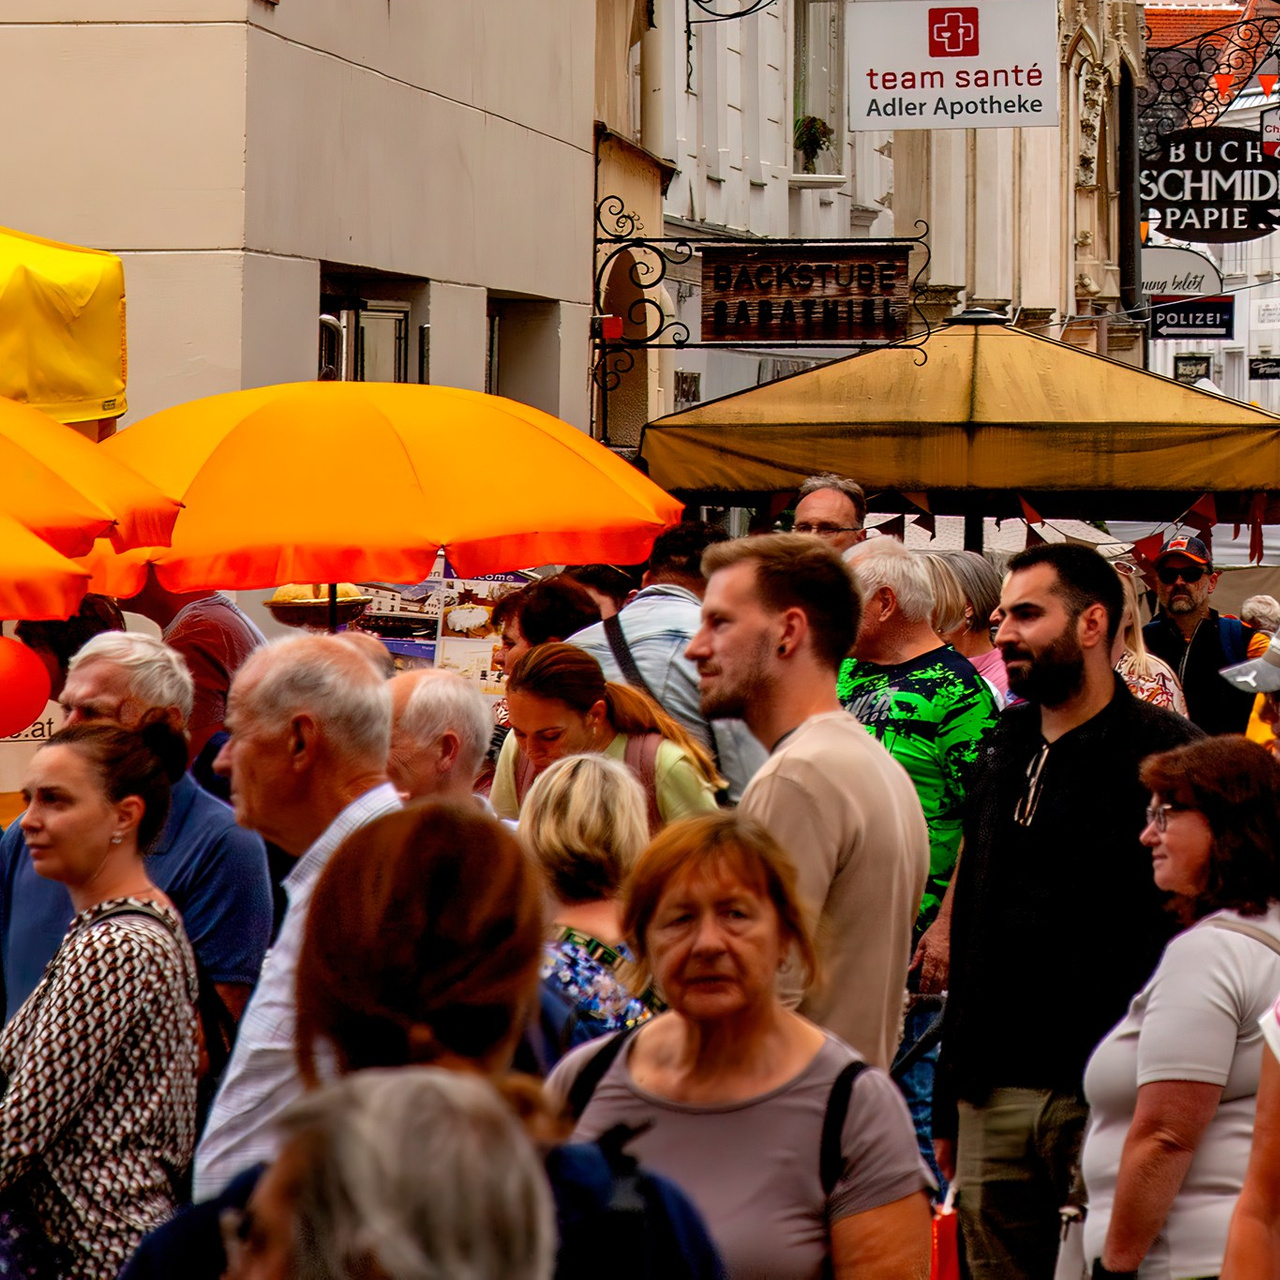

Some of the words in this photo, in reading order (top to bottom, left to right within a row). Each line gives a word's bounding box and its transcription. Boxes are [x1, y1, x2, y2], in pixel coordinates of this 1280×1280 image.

[865, 68, 944, 90] team
[955, 62, 1043, 88] santé
[866, 97, 927, 117] Adler
[933, 94, 1043, 120] Apotheke
[1169, 140, 1263, 163] BUCH
[1165, 207, 1267, 229] PAPIE
[713, 264, 897, 290] BACKSTUBE
[1156, 312, 1221, 325] POLIZEI
